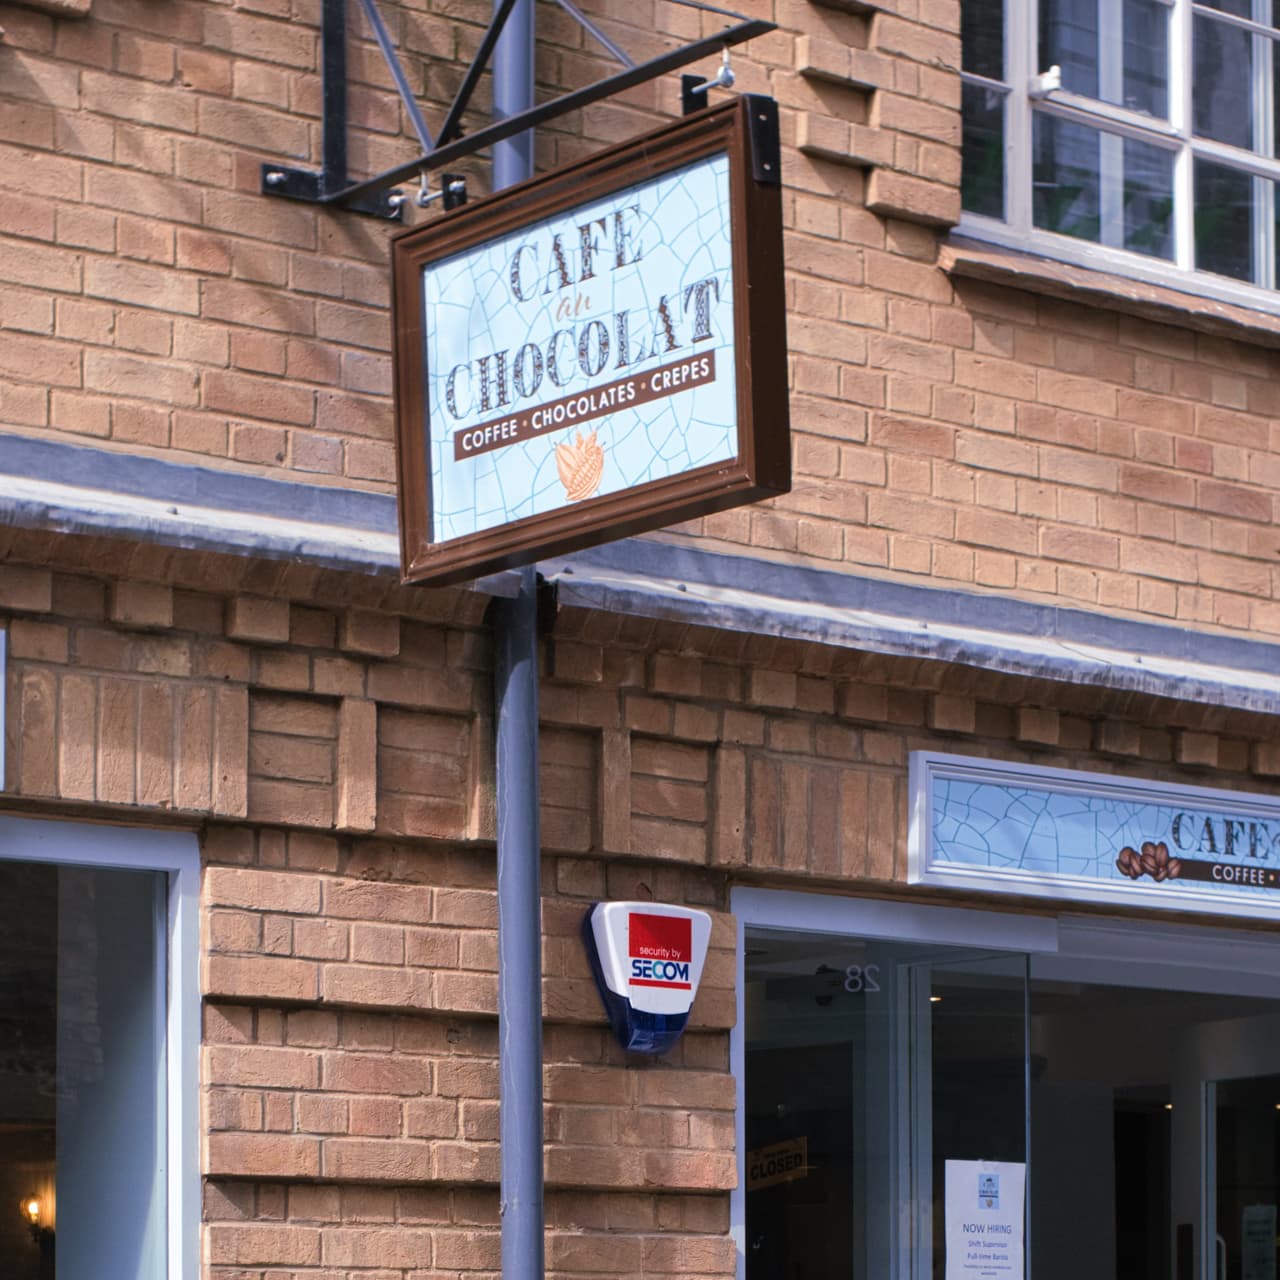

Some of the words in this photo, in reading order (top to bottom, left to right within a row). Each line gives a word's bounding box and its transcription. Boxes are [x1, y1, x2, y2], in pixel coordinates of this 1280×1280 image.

[508, 203, 645, 302] CAFE
[444, 277, 720, 420] CHOCOLAT
[461, 418, 519, 452] COFFEE
[531, 380, 636, 431] CHOCOLATES
[650, 357, 710, 394] CREPES
[1170, 812, 1269, 860] CAFE
[1212, 864, 1266, 885] COFFEE
[639, 945, 671, 958] security
[671, 948, 682, 960] by
[631, 959, 689, 981] SECOM
[750, 1152, 803, 1181] CLOSED
[962, 1223, 985, 1233] NOW
[987, 1224, 1012, 1235] HIRING
